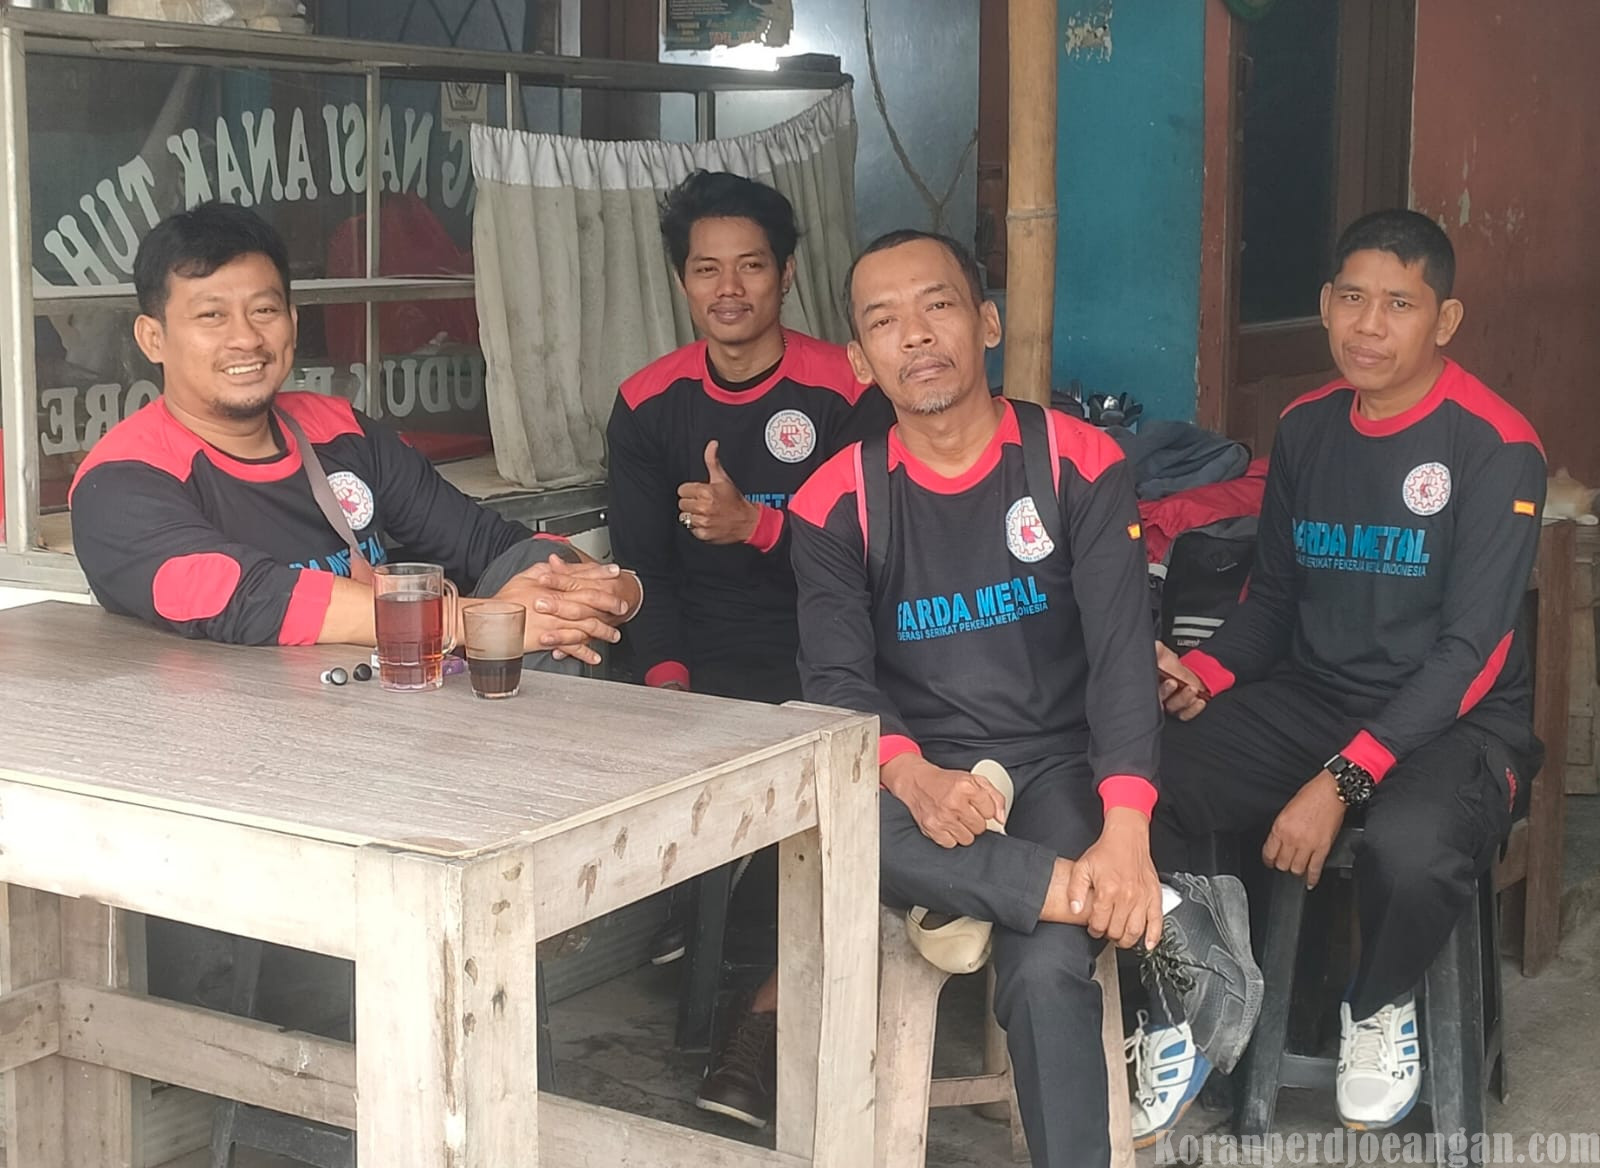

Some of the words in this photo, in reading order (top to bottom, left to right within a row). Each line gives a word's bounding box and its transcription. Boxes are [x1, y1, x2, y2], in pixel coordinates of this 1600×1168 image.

[1351, 524, 1430, 564] METAL
[1382, 562, 1426, 577] INDONESIA
[897, 592, 972, 631] ARDA
[976, 575, 1047, 618] MEAL
[924, 624, 958, 639] SERIKAT
[959, 617, 994, 633] PEKERJA
[994, 611, 1020, 625] META
